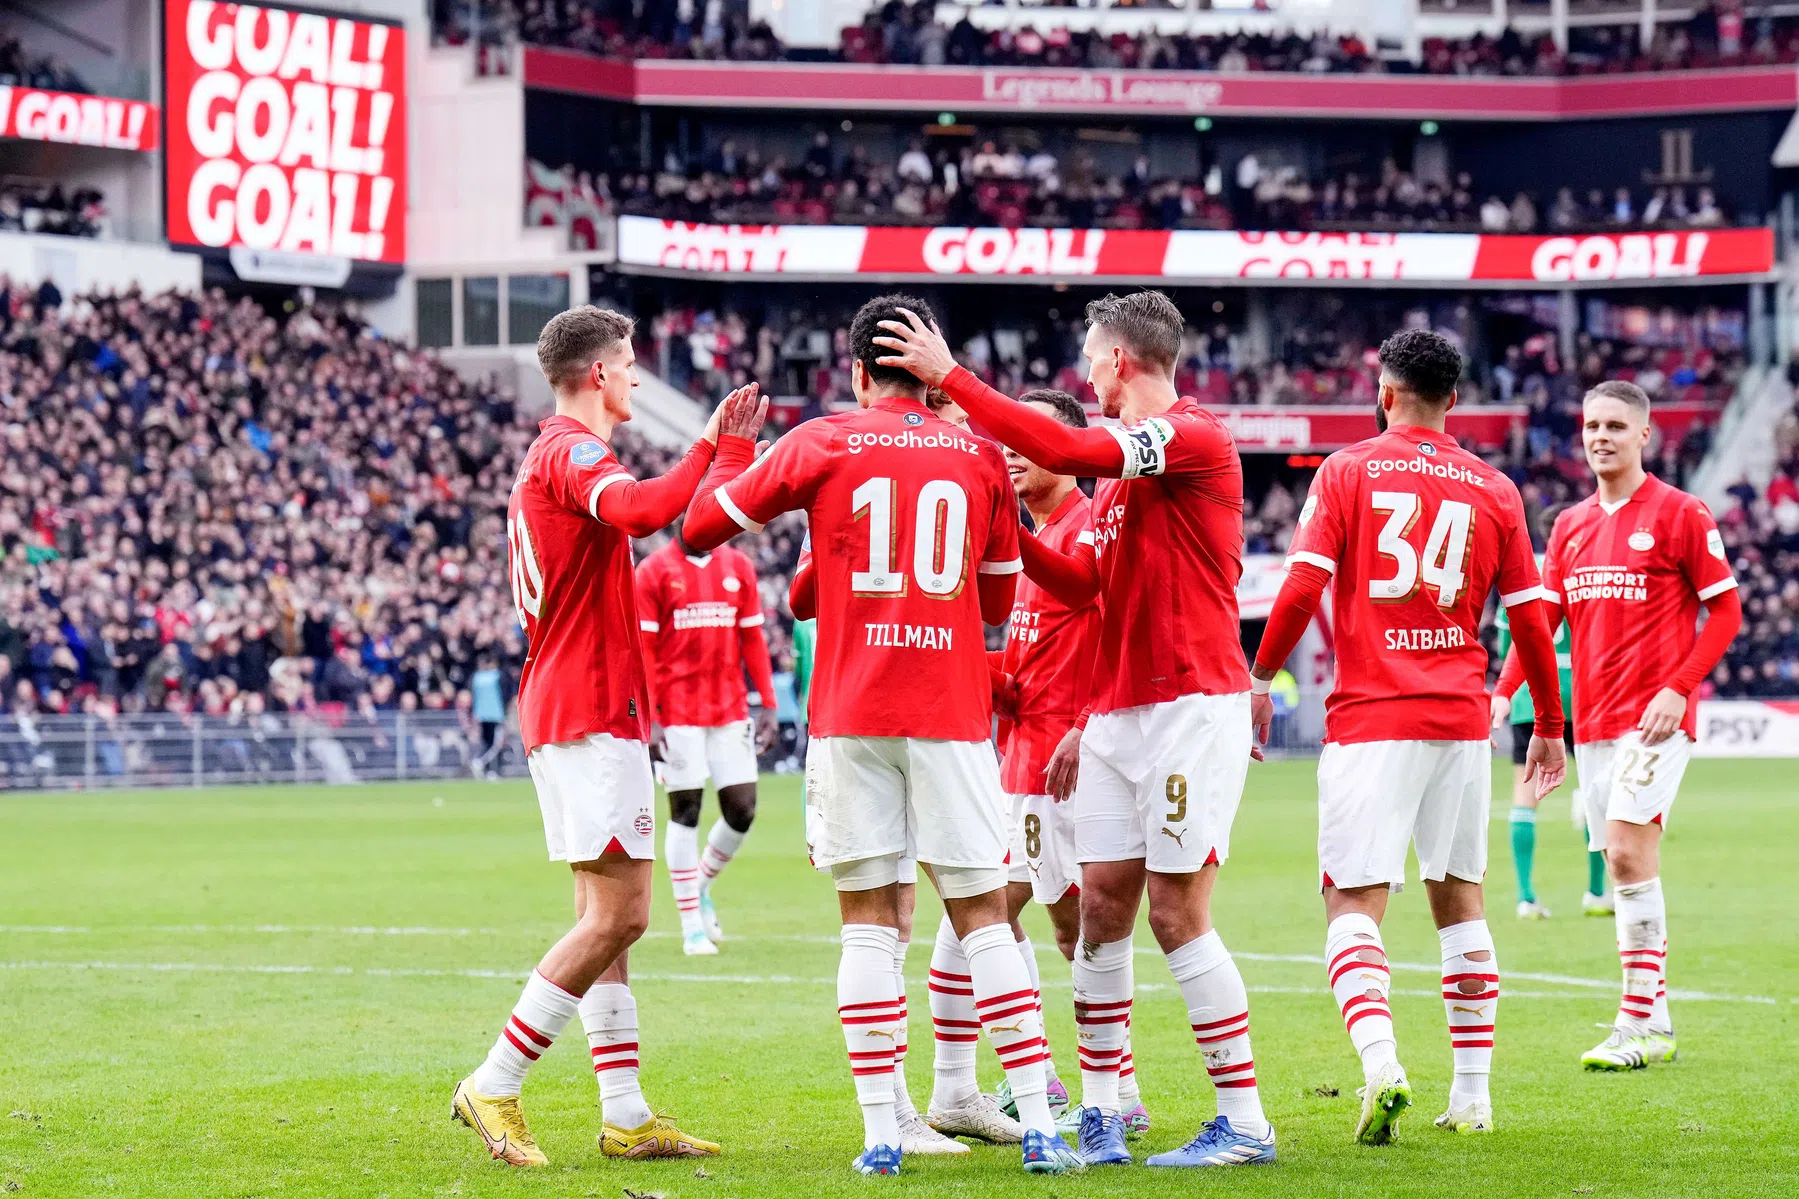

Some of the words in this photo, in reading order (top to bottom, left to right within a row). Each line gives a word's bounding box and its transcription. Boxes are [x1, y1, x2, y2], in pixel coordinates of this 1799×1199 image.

[186, 0, 390, 90] GOAL!
[983, 70, 1106, 108] Legends
[1111, 73, 1222, 112] Lounge
[15, 91, 146, 150] GOAL!
[186, 69, 395, 175] GOAL!
[187, 158, 395, 261] GOAL!
[922, 228, 1104, 275] GOAL!
[1531, 233, 1709, 280] GOAL!
[847, 430, 979, 456] goodhabitz
[1128, 430, 1158, 476] PSV
[1366, 457, 1485, 488] goodhabitz
[851, 477, 971, 600] 10
[1369, 491, 1476, 613] 34
[1562, 572, 1648, 592] BRAINPORT
[865, 623, 952, 650] TILLMAN
[1385, 626, 1465, 650] SAIBARI
[1706, 716, 1771, 744] PSV
[1619, 749, 1660, 786] 23
[1166, 774, 1187, 823] 9
[1024, 813, 1041, 859] 8
